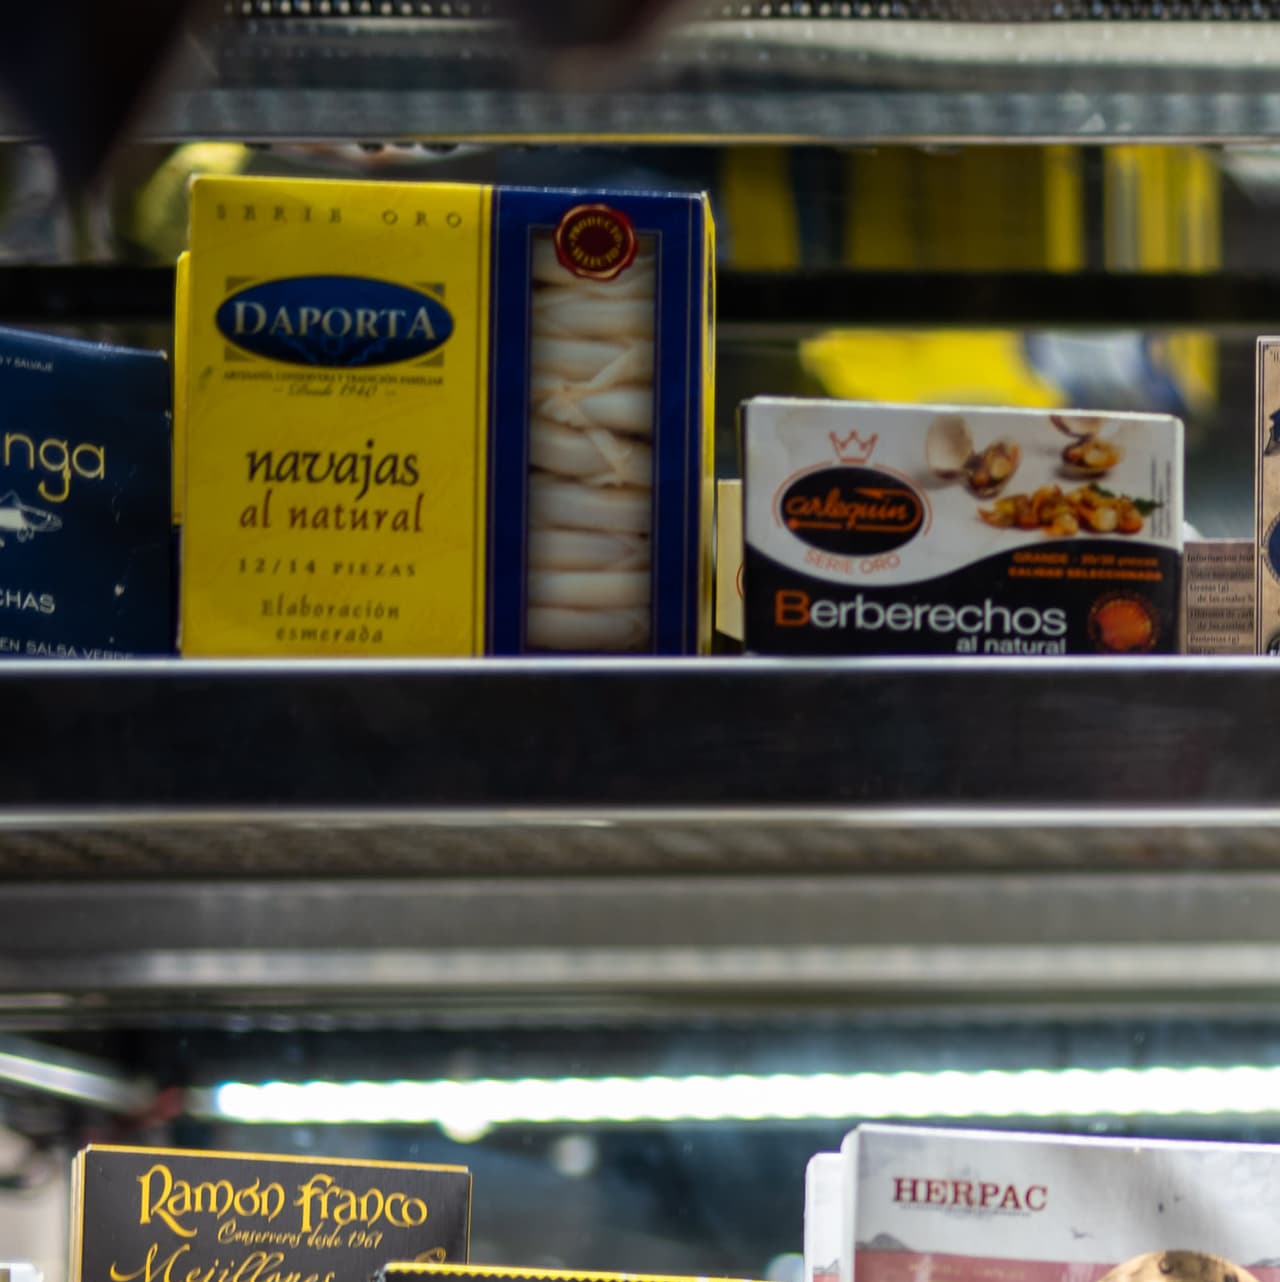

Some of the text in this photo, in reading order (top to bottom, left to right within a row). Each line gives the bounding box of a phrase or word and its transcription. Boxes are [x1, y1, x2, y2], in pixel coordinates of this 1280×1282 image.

[216, 204, 462, 229] SERIE ORO
[233, 300, 436, 341] DAPORTA
[245, 438, 420, 502] navajas
[239, 487, 425, 533] al natural
[333, 561, 417, 577] PIEZAS
[804, 552, 902, 577] SERIE ORO
[773, 589, 1068, 637] Berberechos
[26, 640, 77, 659] SALSA
[956, 635, 1067, 655] al natural
[136, 1163, 285, 1238] Ramón
[891, 1176, 1049, 1212] HERPAC
